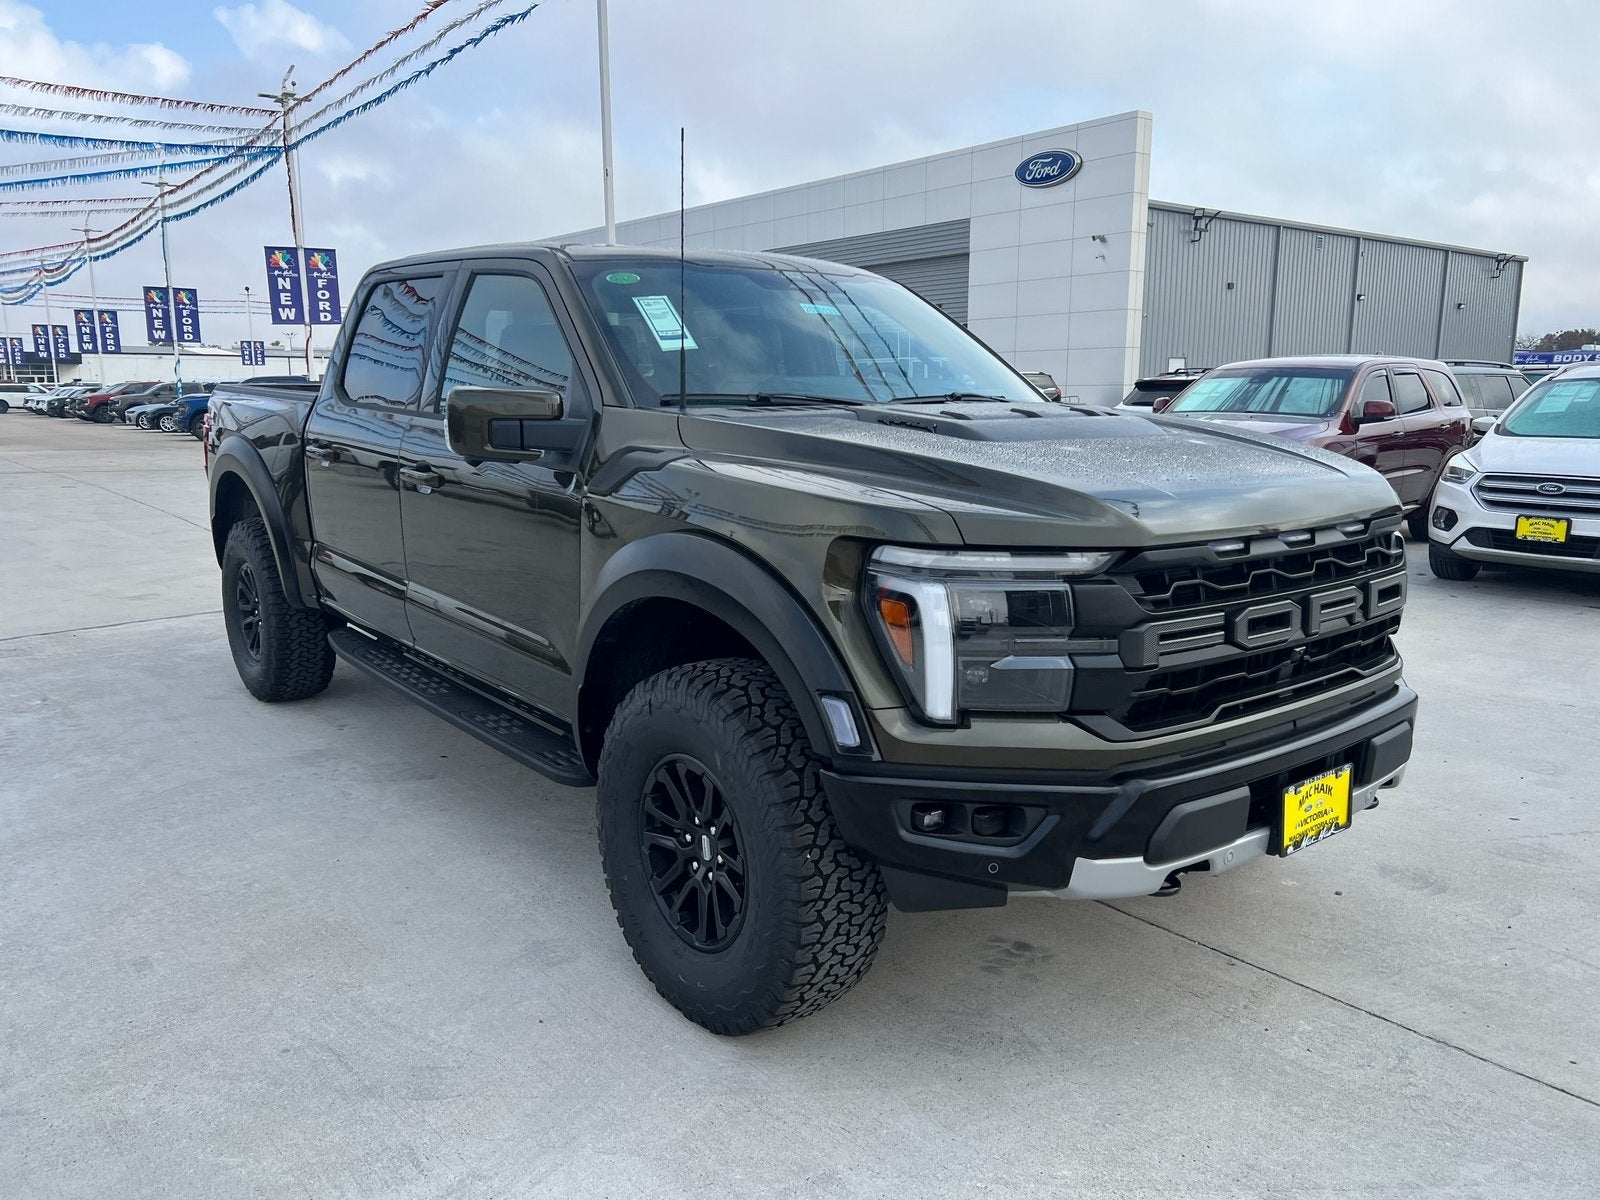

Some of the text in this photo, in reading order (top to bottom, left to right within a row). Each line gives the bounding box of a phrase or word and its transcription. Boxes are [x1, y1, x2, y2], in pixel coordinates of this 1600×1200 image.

[1025, 157, 1062, 180] Ford
[277, 277, 296, 320] NEW
[316, 278, 332, 322] FORD
[152, 308, 166, 339] NEW
[181, 309, 194, 340] FORD
[37, 337, 47, 358] NEW
[57, 338, 66, 358] FORD
[81, 326, 93, 350] NEW
[105, 327, 115, 351] FORD
[1553, 354, 1592, 363] BODY
[1138, 571, 1407, 671] FORD
[1298, 783, 1333, 810] MAC HAIK
[1300, 808, 1328, 828] VICTORIA
